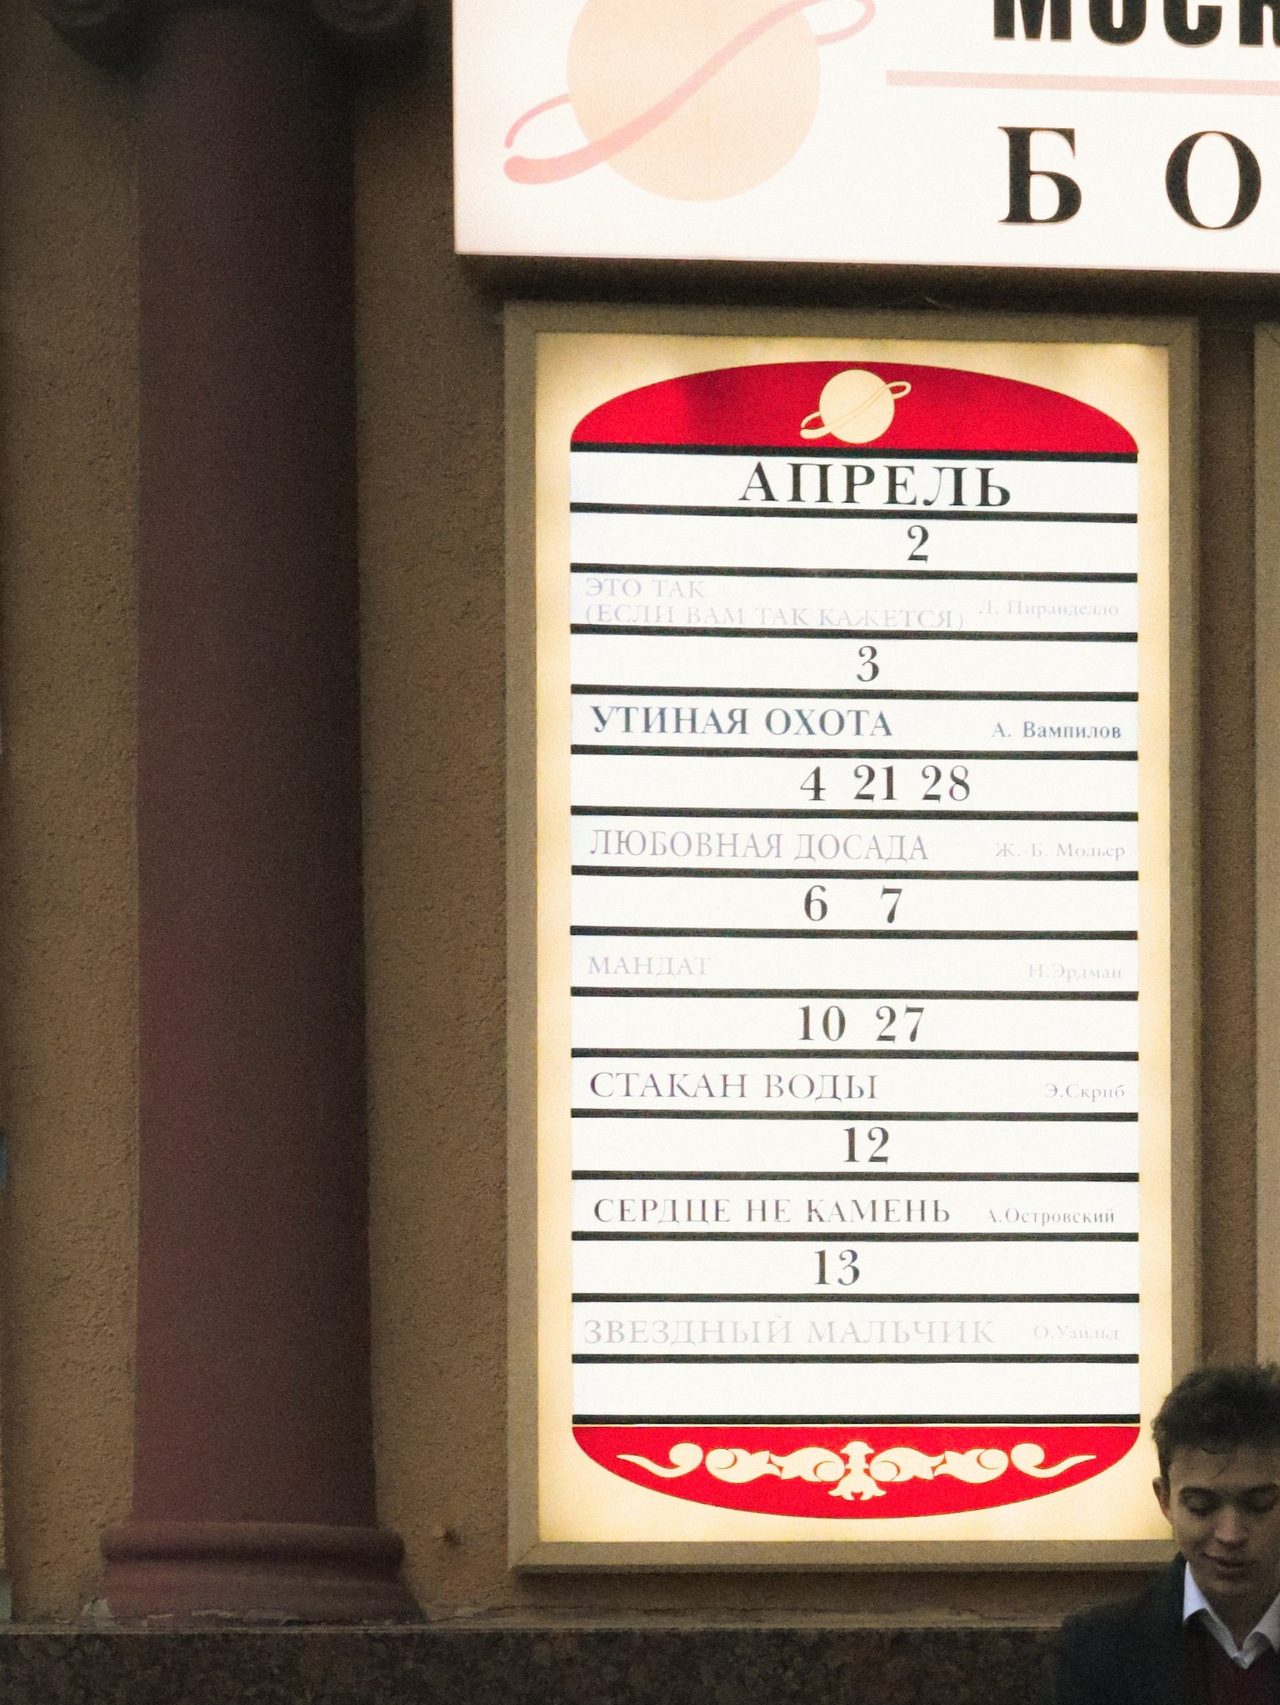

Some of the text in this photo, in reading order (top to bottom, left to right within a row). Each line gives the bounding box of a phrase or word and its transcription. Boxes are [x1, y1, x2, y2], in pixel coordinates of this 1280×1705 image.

[739, 459, 1012, 509] АПРЕЛЬ
[907, 523, 930, 564] 2
[585, 578, 706, 599] ЭТО ТАК
[687, 607, 745, 625] ВАМ
[755, 608, 809, 626] ТАК
[855, 645, 881, 683] 3
[590, 705, 1122, 739] УТИНАЯ ОХОТА А. Вампилов
[799, 764, 971, 803] 4 21 28
[590, 829, 783, 859] ЛЮБОВНАЯ
[793, 832, 929, 863] ДОСАДА
[802, 884, 904, 924] 6 7
[588, 956, 711, 976] МАНДАТ
[797, 1004, 925, 1044] 10 27
[589, 1072, 749, 1099] СТАКАН
[763, 1073, 879, 1102] ВОДЫ
[843, 1126, 891, 1165] 12
[593, 1198, 1115, 1226] СЕРДЦЕ НЕ КАМЕНЬ А.Островский
[814, 1249, 861, 1287] 13
[584, 1314, 792, 1346] ЗВЕЗДНЫЙ
[807, 1320, 995, 1344] МАЛЬЧИК
